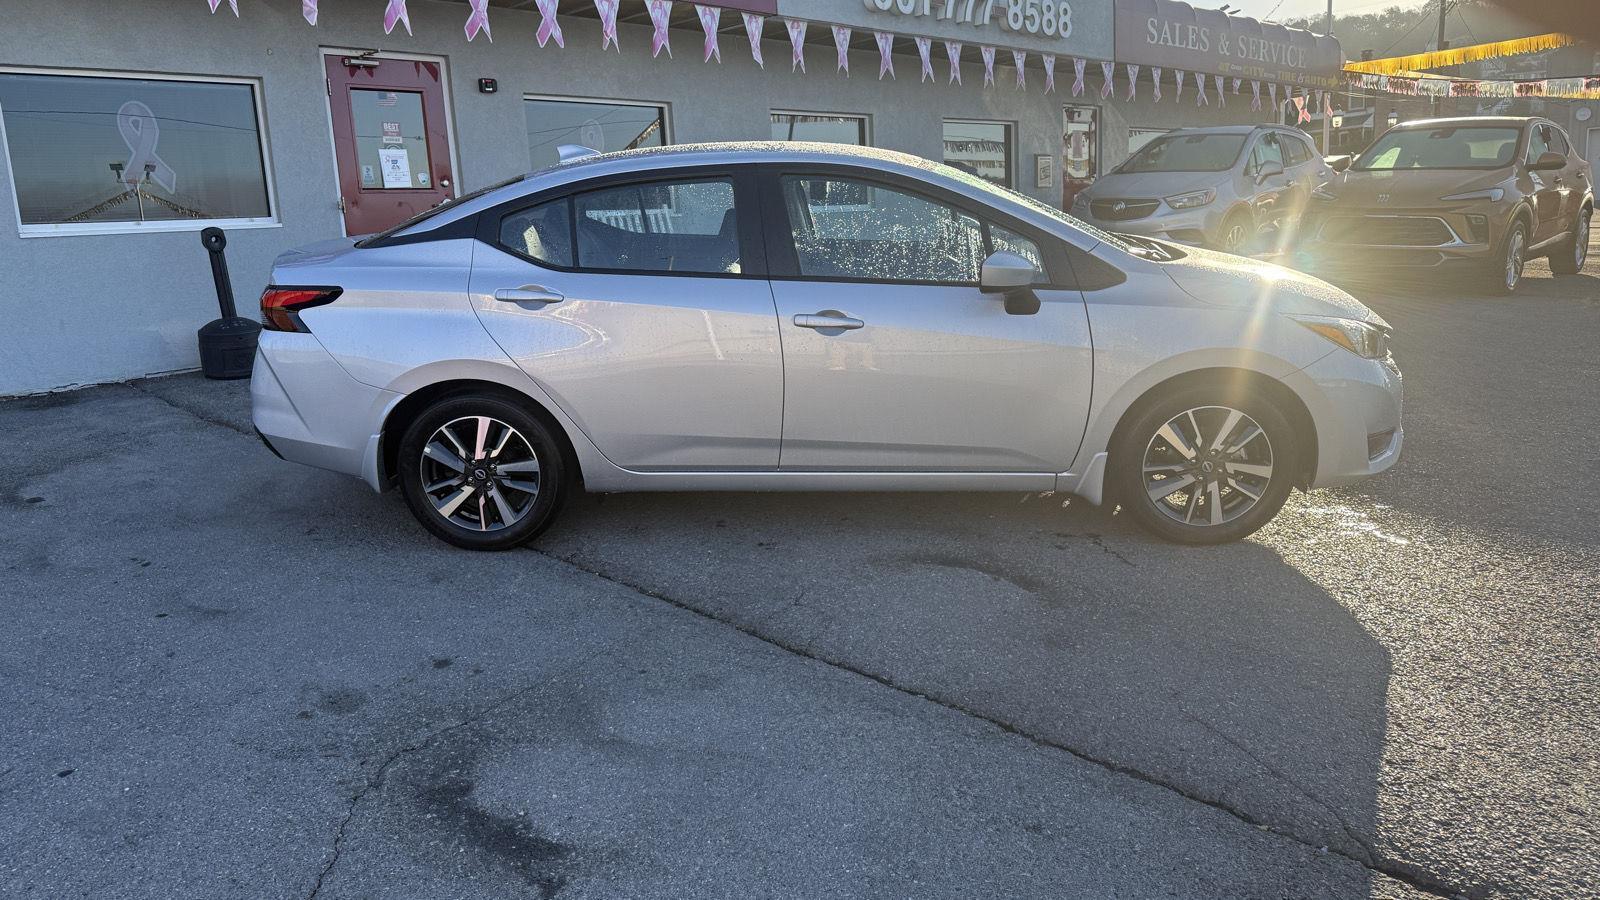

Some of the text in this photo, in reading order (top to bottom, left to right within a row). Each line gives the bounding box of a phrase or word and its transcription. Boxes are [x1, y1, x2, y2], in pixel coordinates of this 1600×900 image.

[1147, 17, 1307, 69] SALES & SERVICE
[383, 122, 400, 130] BEST
